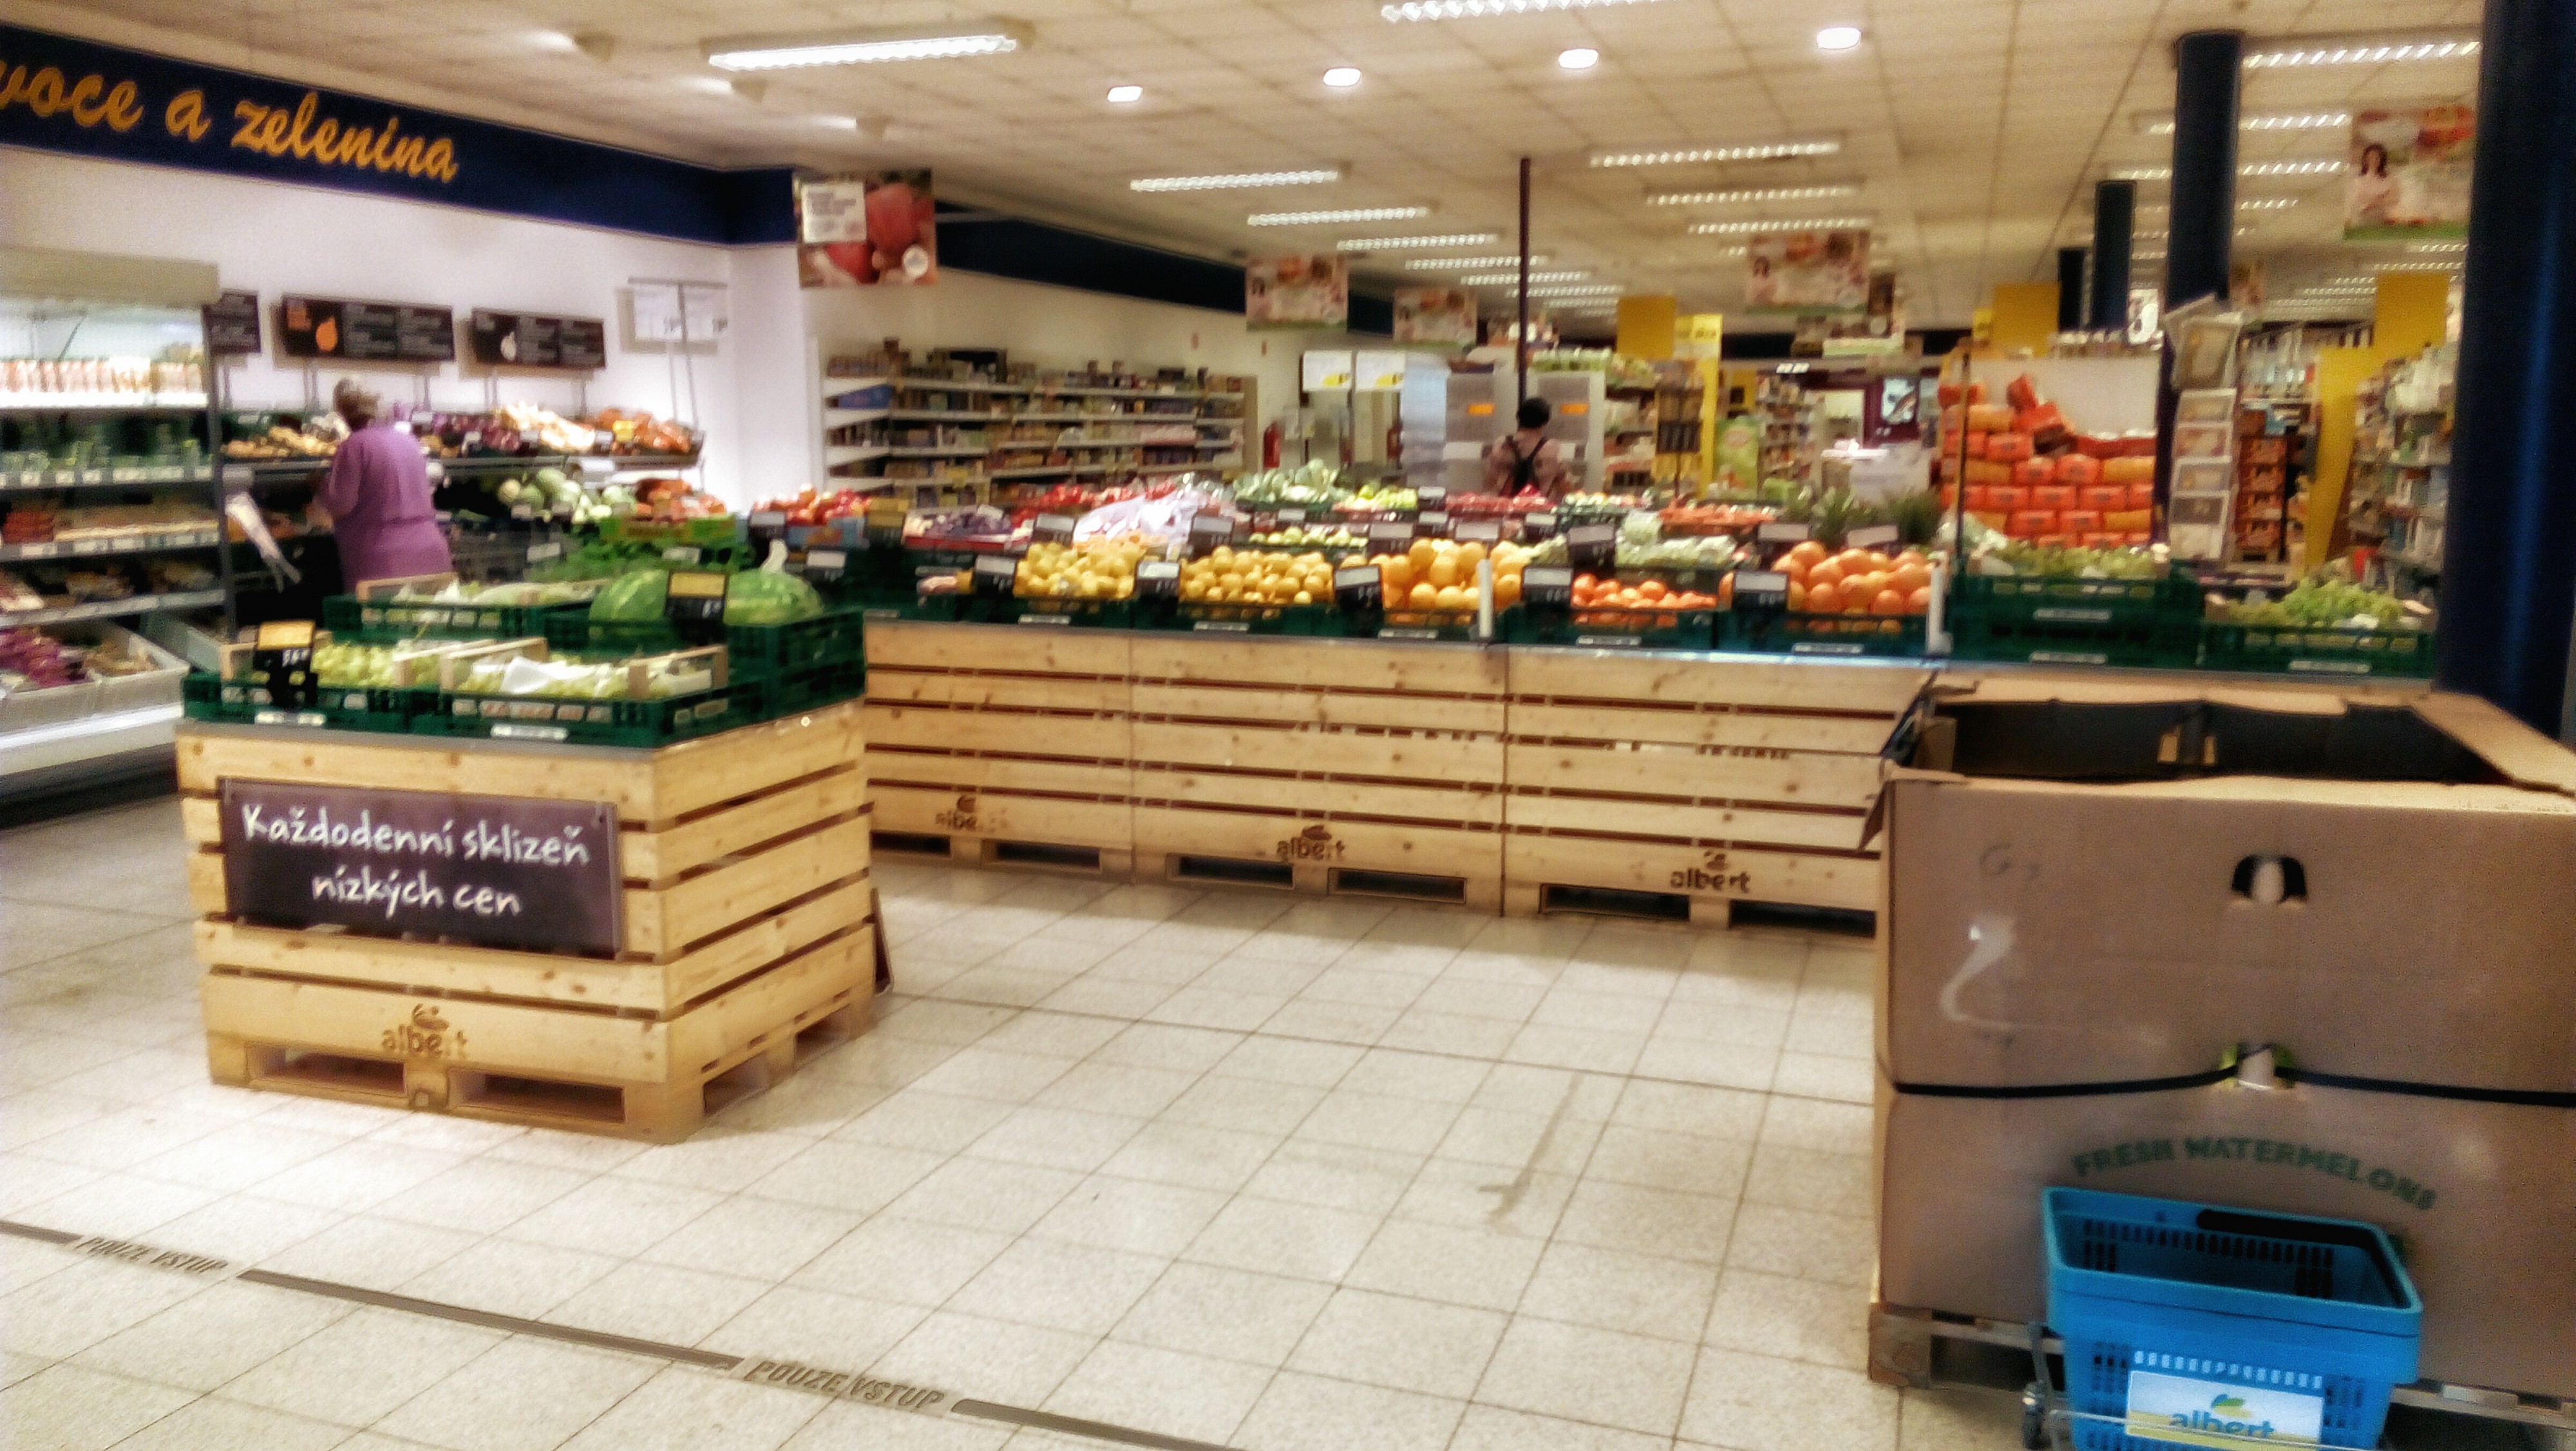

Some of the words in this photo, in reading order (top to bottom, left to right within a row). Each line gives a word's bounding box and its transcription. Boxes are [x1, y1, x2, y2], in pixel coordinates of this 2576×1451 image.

[165, 89, 211, 142] a
[230, 91, 459, 183] zelenina
[241, 803, 454, 858] Každodenní
[461, 820, 590, 866] sklizeň
[312, 864, 444, 919] nízkých
[453, 884, 523, 916] cen
[1670, 868, 1751, 894] albert
[381, 1023, 469, 1059] albet
[2071, 1137, 2174, 1177] FRESH
[2185, 1135, 2438, 1211] WATERMELONS
[743, 1360, 849, 1392] POUZE
[850, 1378, 945, 1408] VSTUP
[2170, 1408, 2276, 1439] albert
